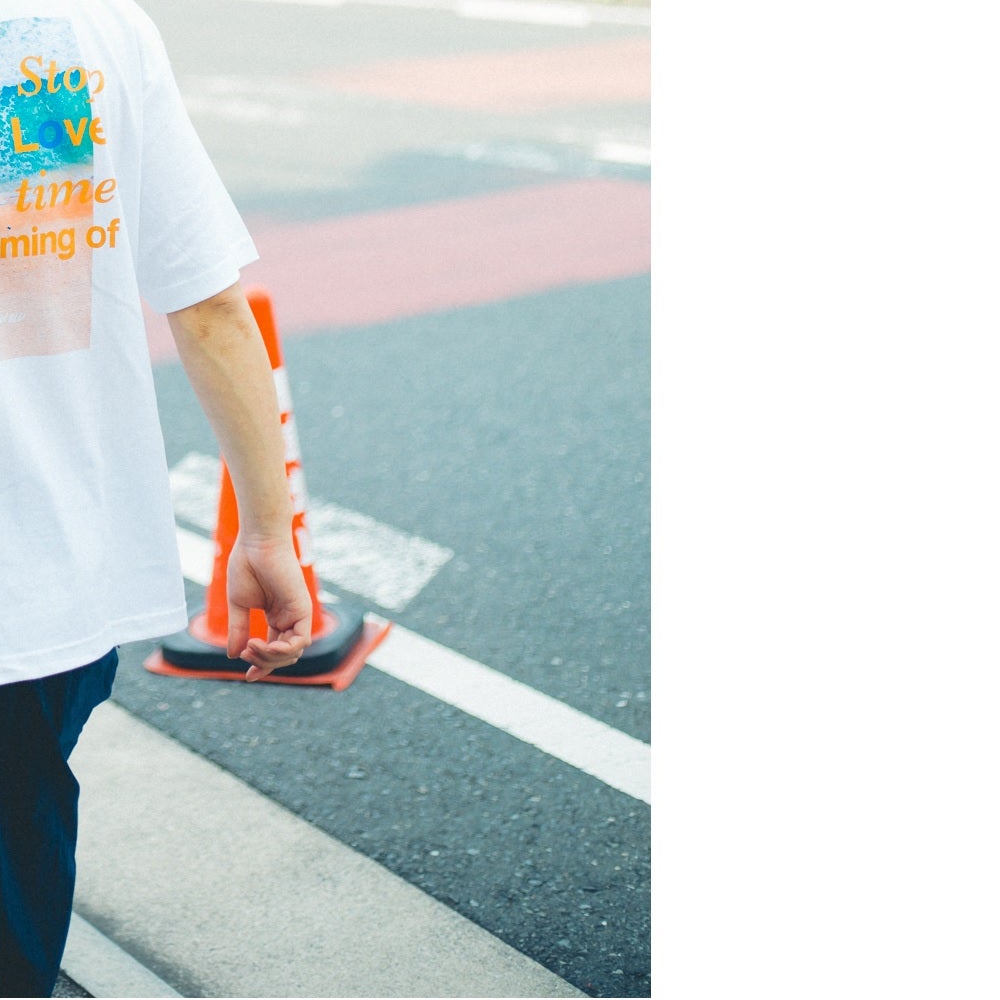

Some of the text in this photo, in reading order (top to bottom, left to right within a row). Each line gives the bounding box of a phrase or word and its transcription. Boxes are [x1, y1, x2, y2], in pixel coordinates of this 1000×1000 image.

[17, 55, 105, 103] Stop
[11, 117, 107, 154] Love
[16, 169, 117, 213] time
[86, 217, 120, 249] of
